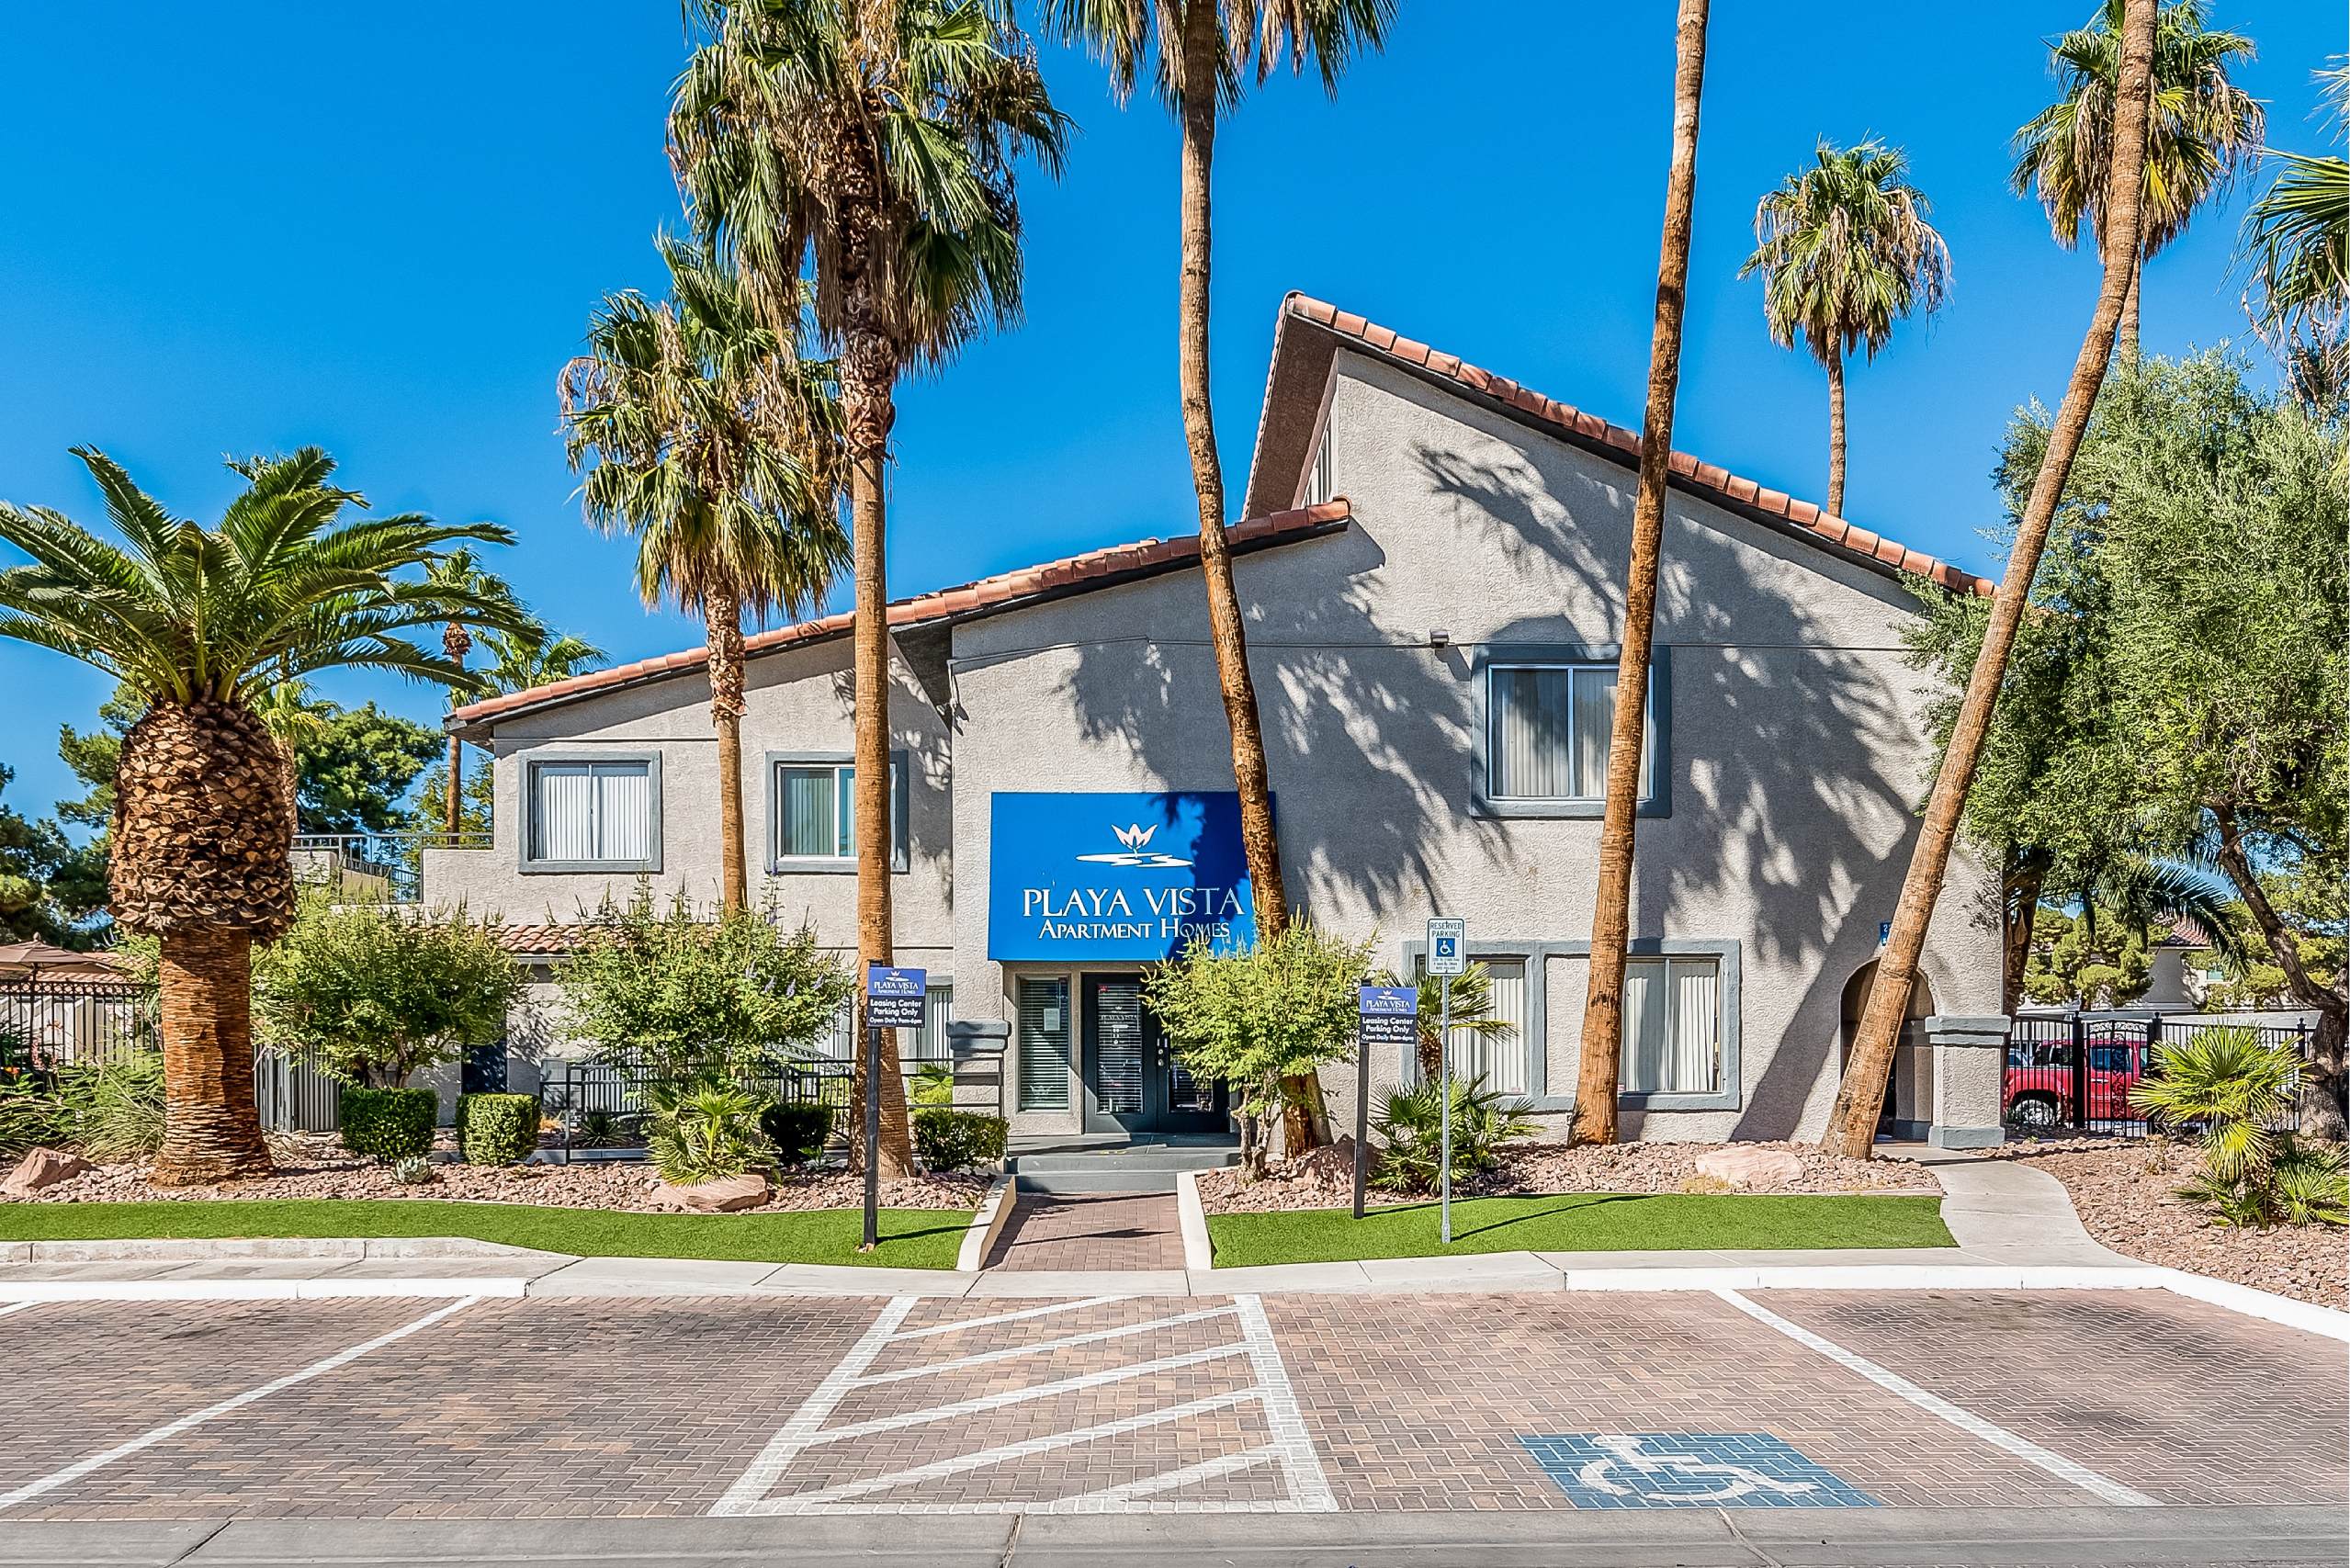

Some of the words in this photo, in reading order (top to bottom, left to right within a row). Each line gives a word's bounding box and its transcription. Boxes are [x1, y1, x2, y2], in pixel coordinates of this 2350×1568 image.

[1022, 888, 1134, 917] PLAYA
[1143, 887, 1246, 916] VISTA
[1038, 919, 1153, 939] APARTMENT
[1160, 918, 1230, 939] HOMES
[1429, 921, 1463, 930] RESERVED
[1431, 930, 1461, 938] PARKING
[874, 981, 897, 989] PLAYA
[898, 981, 919, 990] VISTA
[870, 998, 897, 1009] Leasing
[898, 998, 922, 1008] Center
[1366, 999, 1389, 1008] PLAYA
[1389, 999, 1410, 1009] VISTA
[874, 1007, 900, 1017] Parking
[900, 1008, 919, 1018] Only
[869, 1016, 884, 1024] Open
[1361, 1016, 1388, 1026] Leasing
[1389, 1017, 1414, 1025] Center
[1365, 1024, 1392, 1034] Parking
[1392, 1025, 1410, 1034] Only
